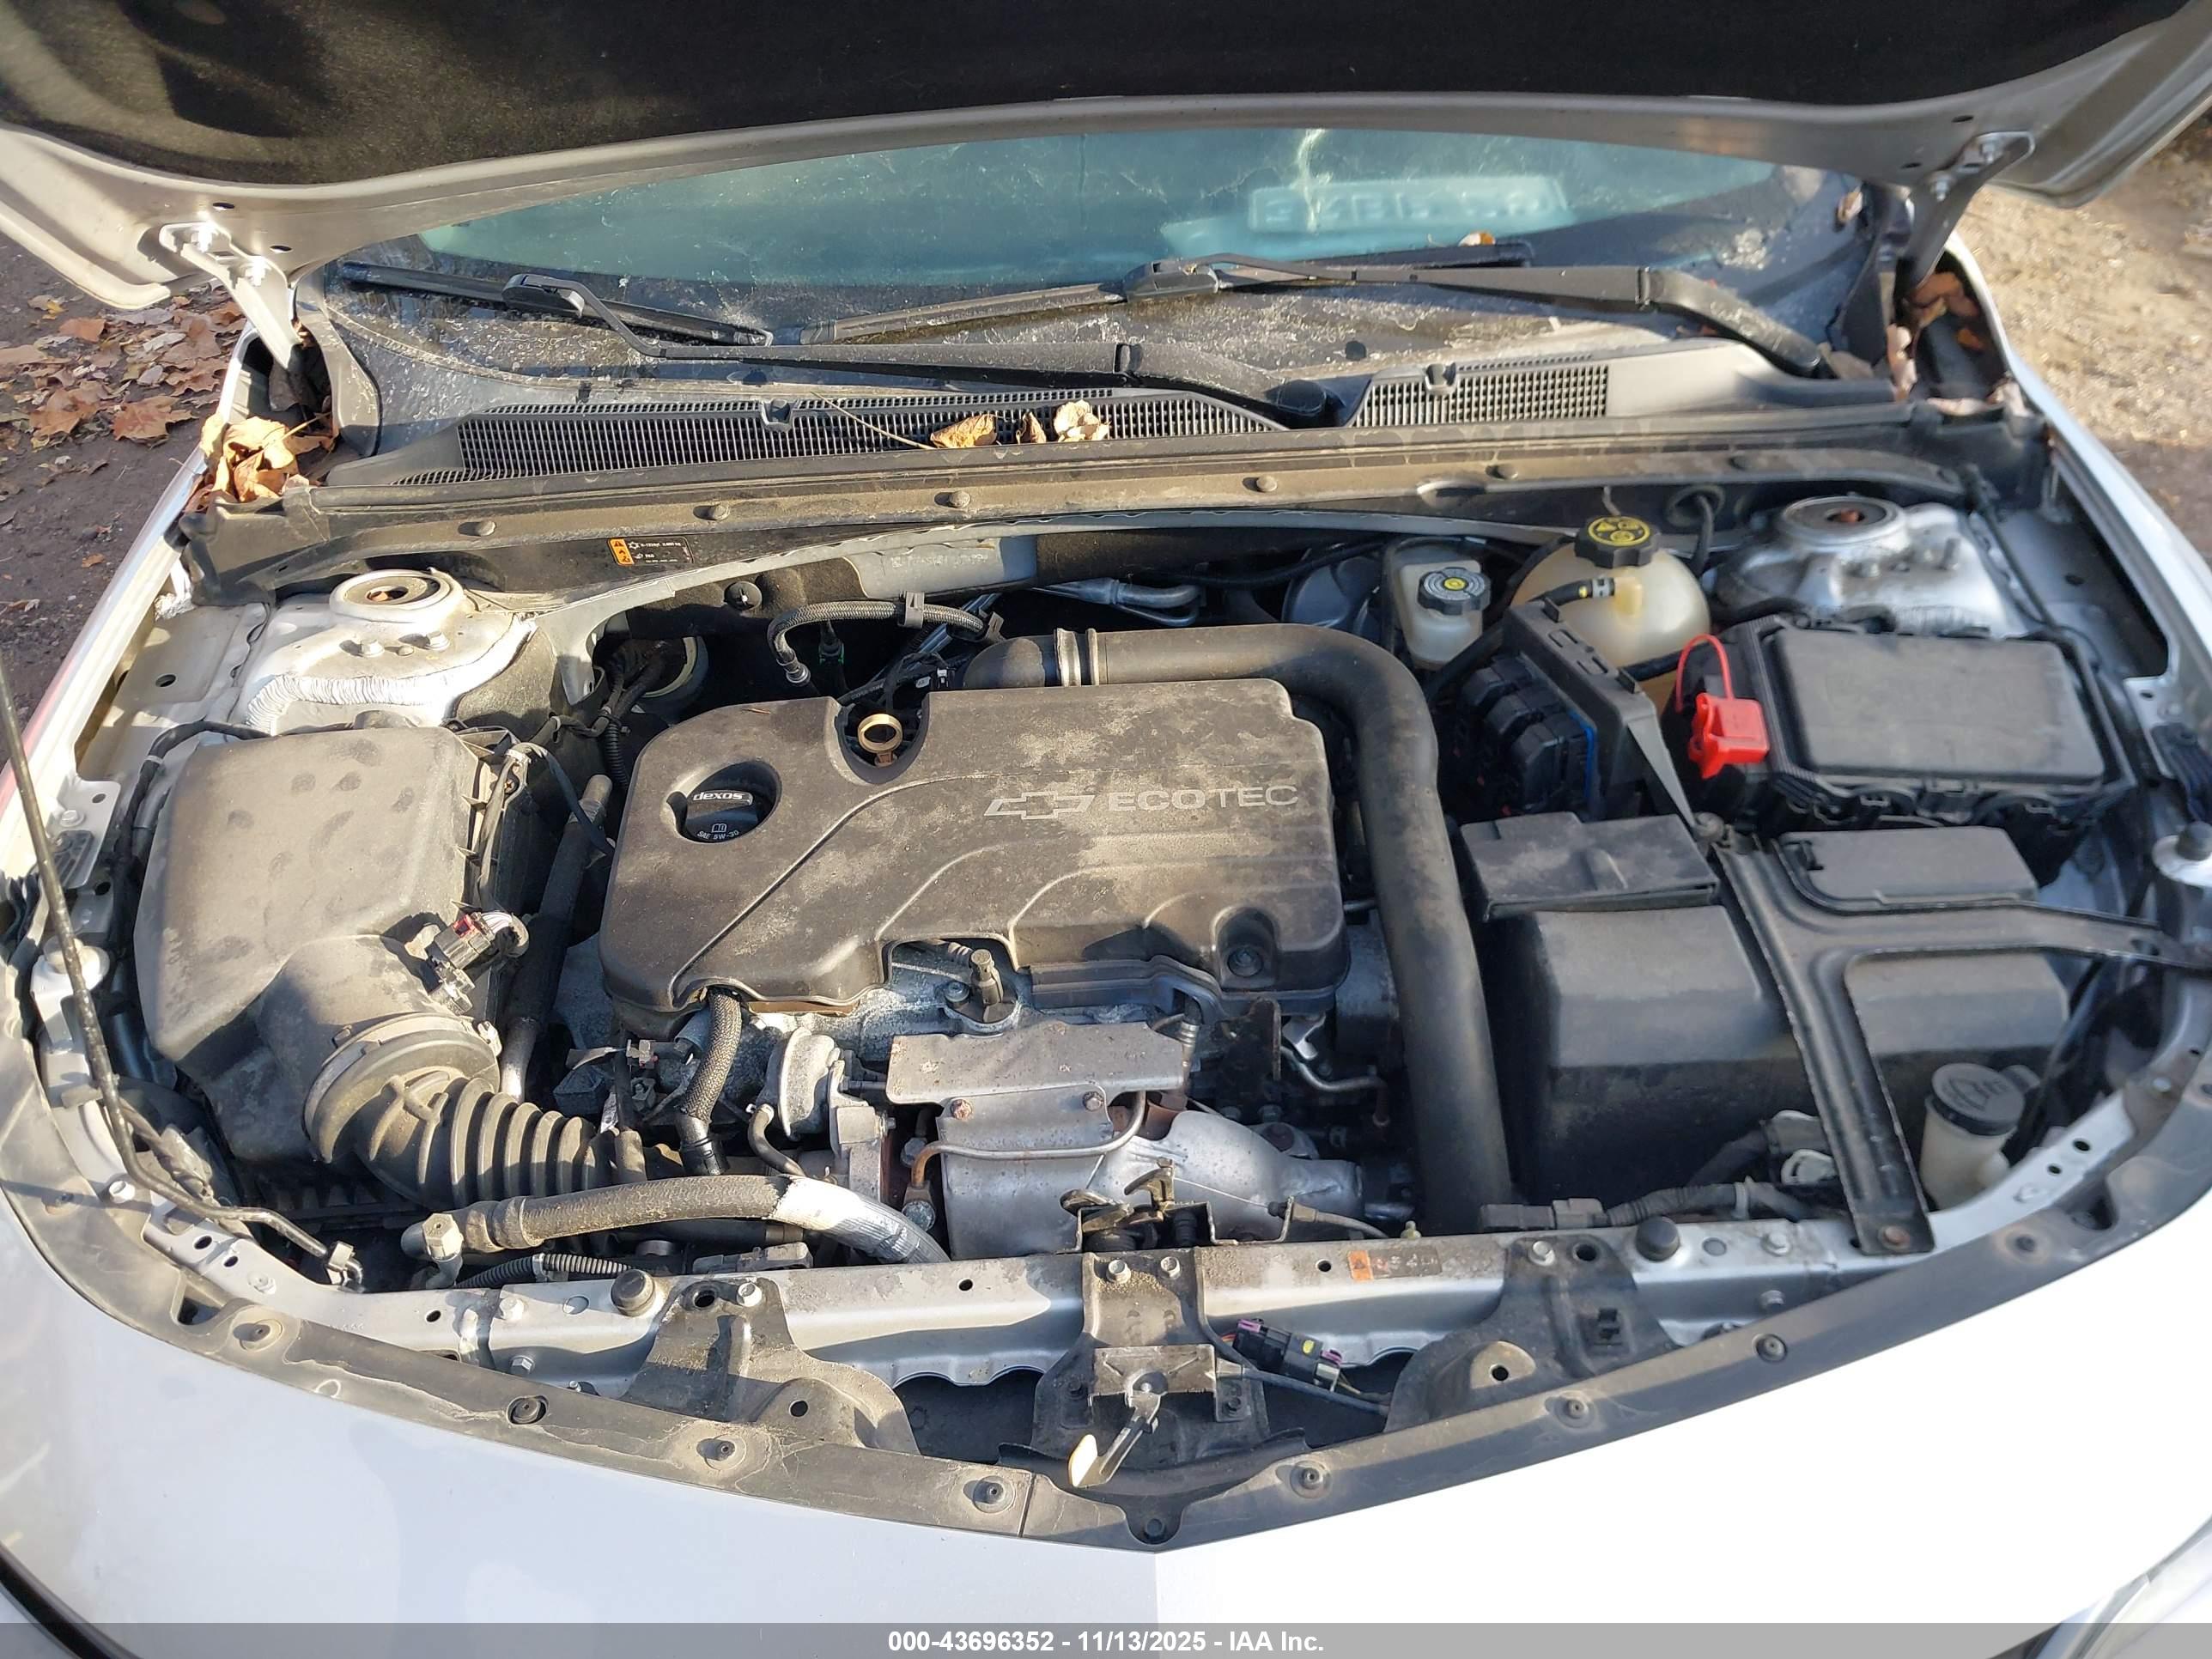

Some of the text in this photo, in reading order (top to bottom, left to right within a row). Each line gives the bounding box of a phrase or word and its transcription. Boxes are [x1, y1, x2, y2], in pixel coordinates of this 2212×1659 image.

[692, 792, 745, 801] dexos
[1109, 785, 1299, 811] ECOTEC
[696, 830, 739, 840] SAE 5W-30
